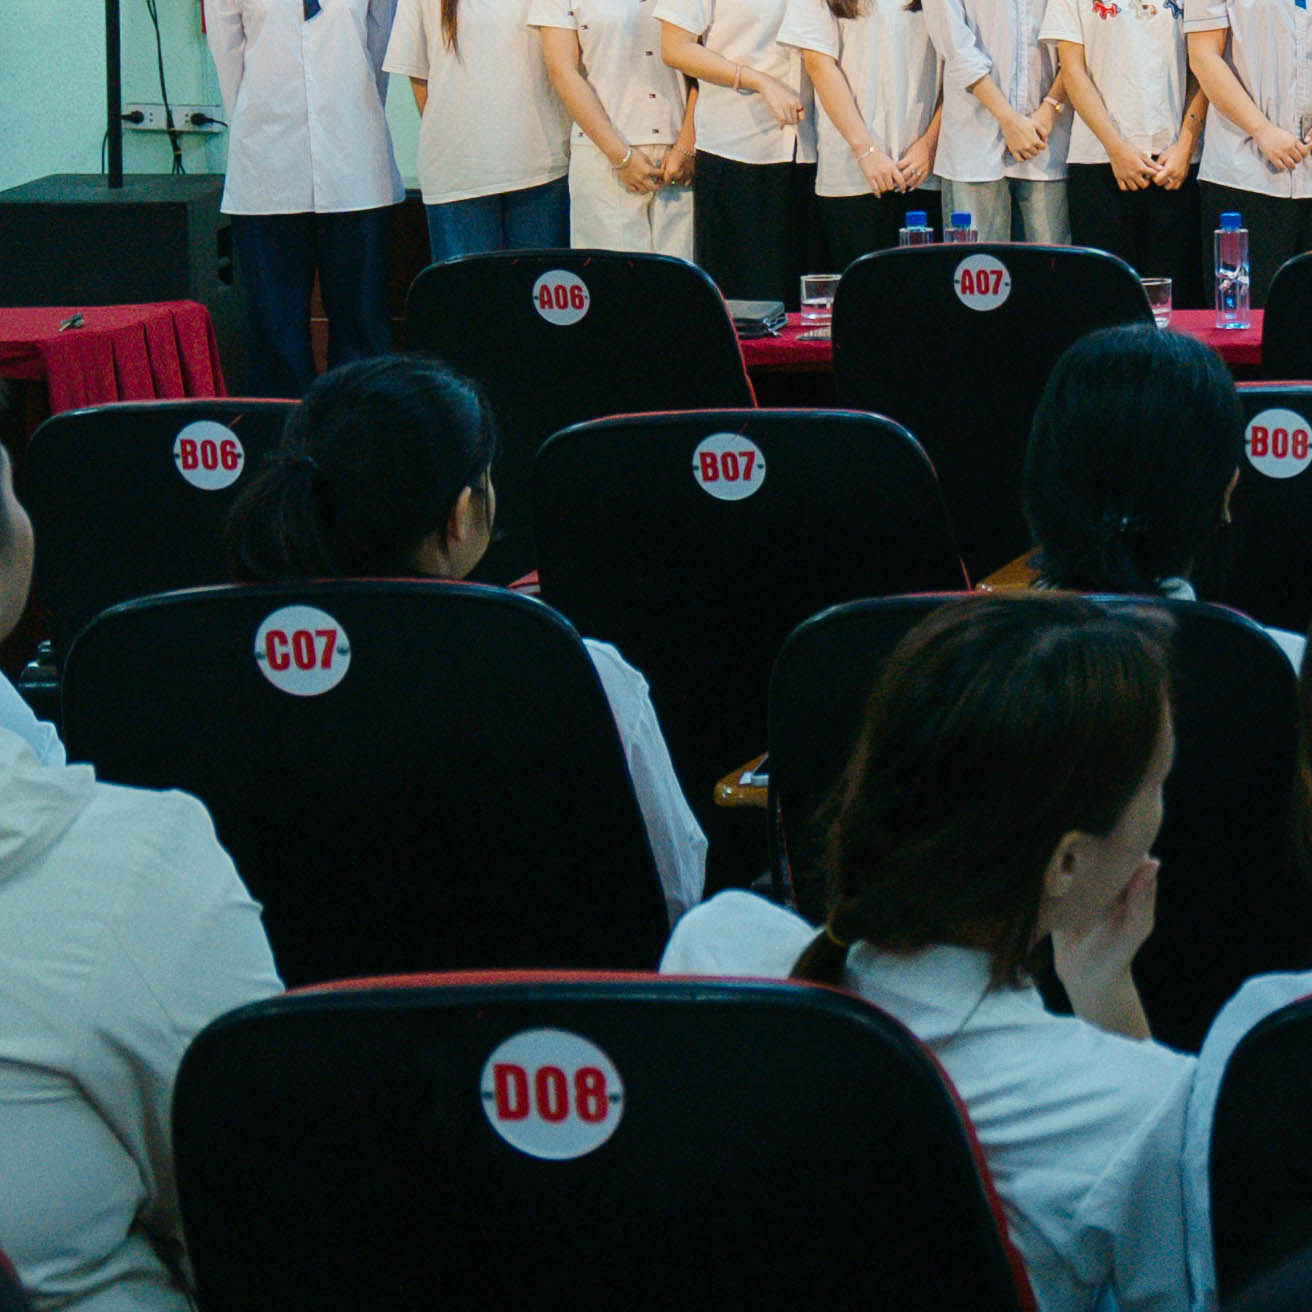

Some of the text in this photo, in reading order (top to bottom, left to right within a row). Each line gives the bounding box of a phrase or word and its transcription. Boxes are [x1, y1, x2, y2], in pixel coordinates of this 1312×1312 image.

[539, 284, 585, 310] A06
[960, 269, 1003, 295] A07
[180, 439, 238, 470] B06
[1250, 426, 1308, 459] B08
[700, 451, 755, 482] B07
[265, 629, 337, 671] C07
[494, 1063, 609, 1123] D08
